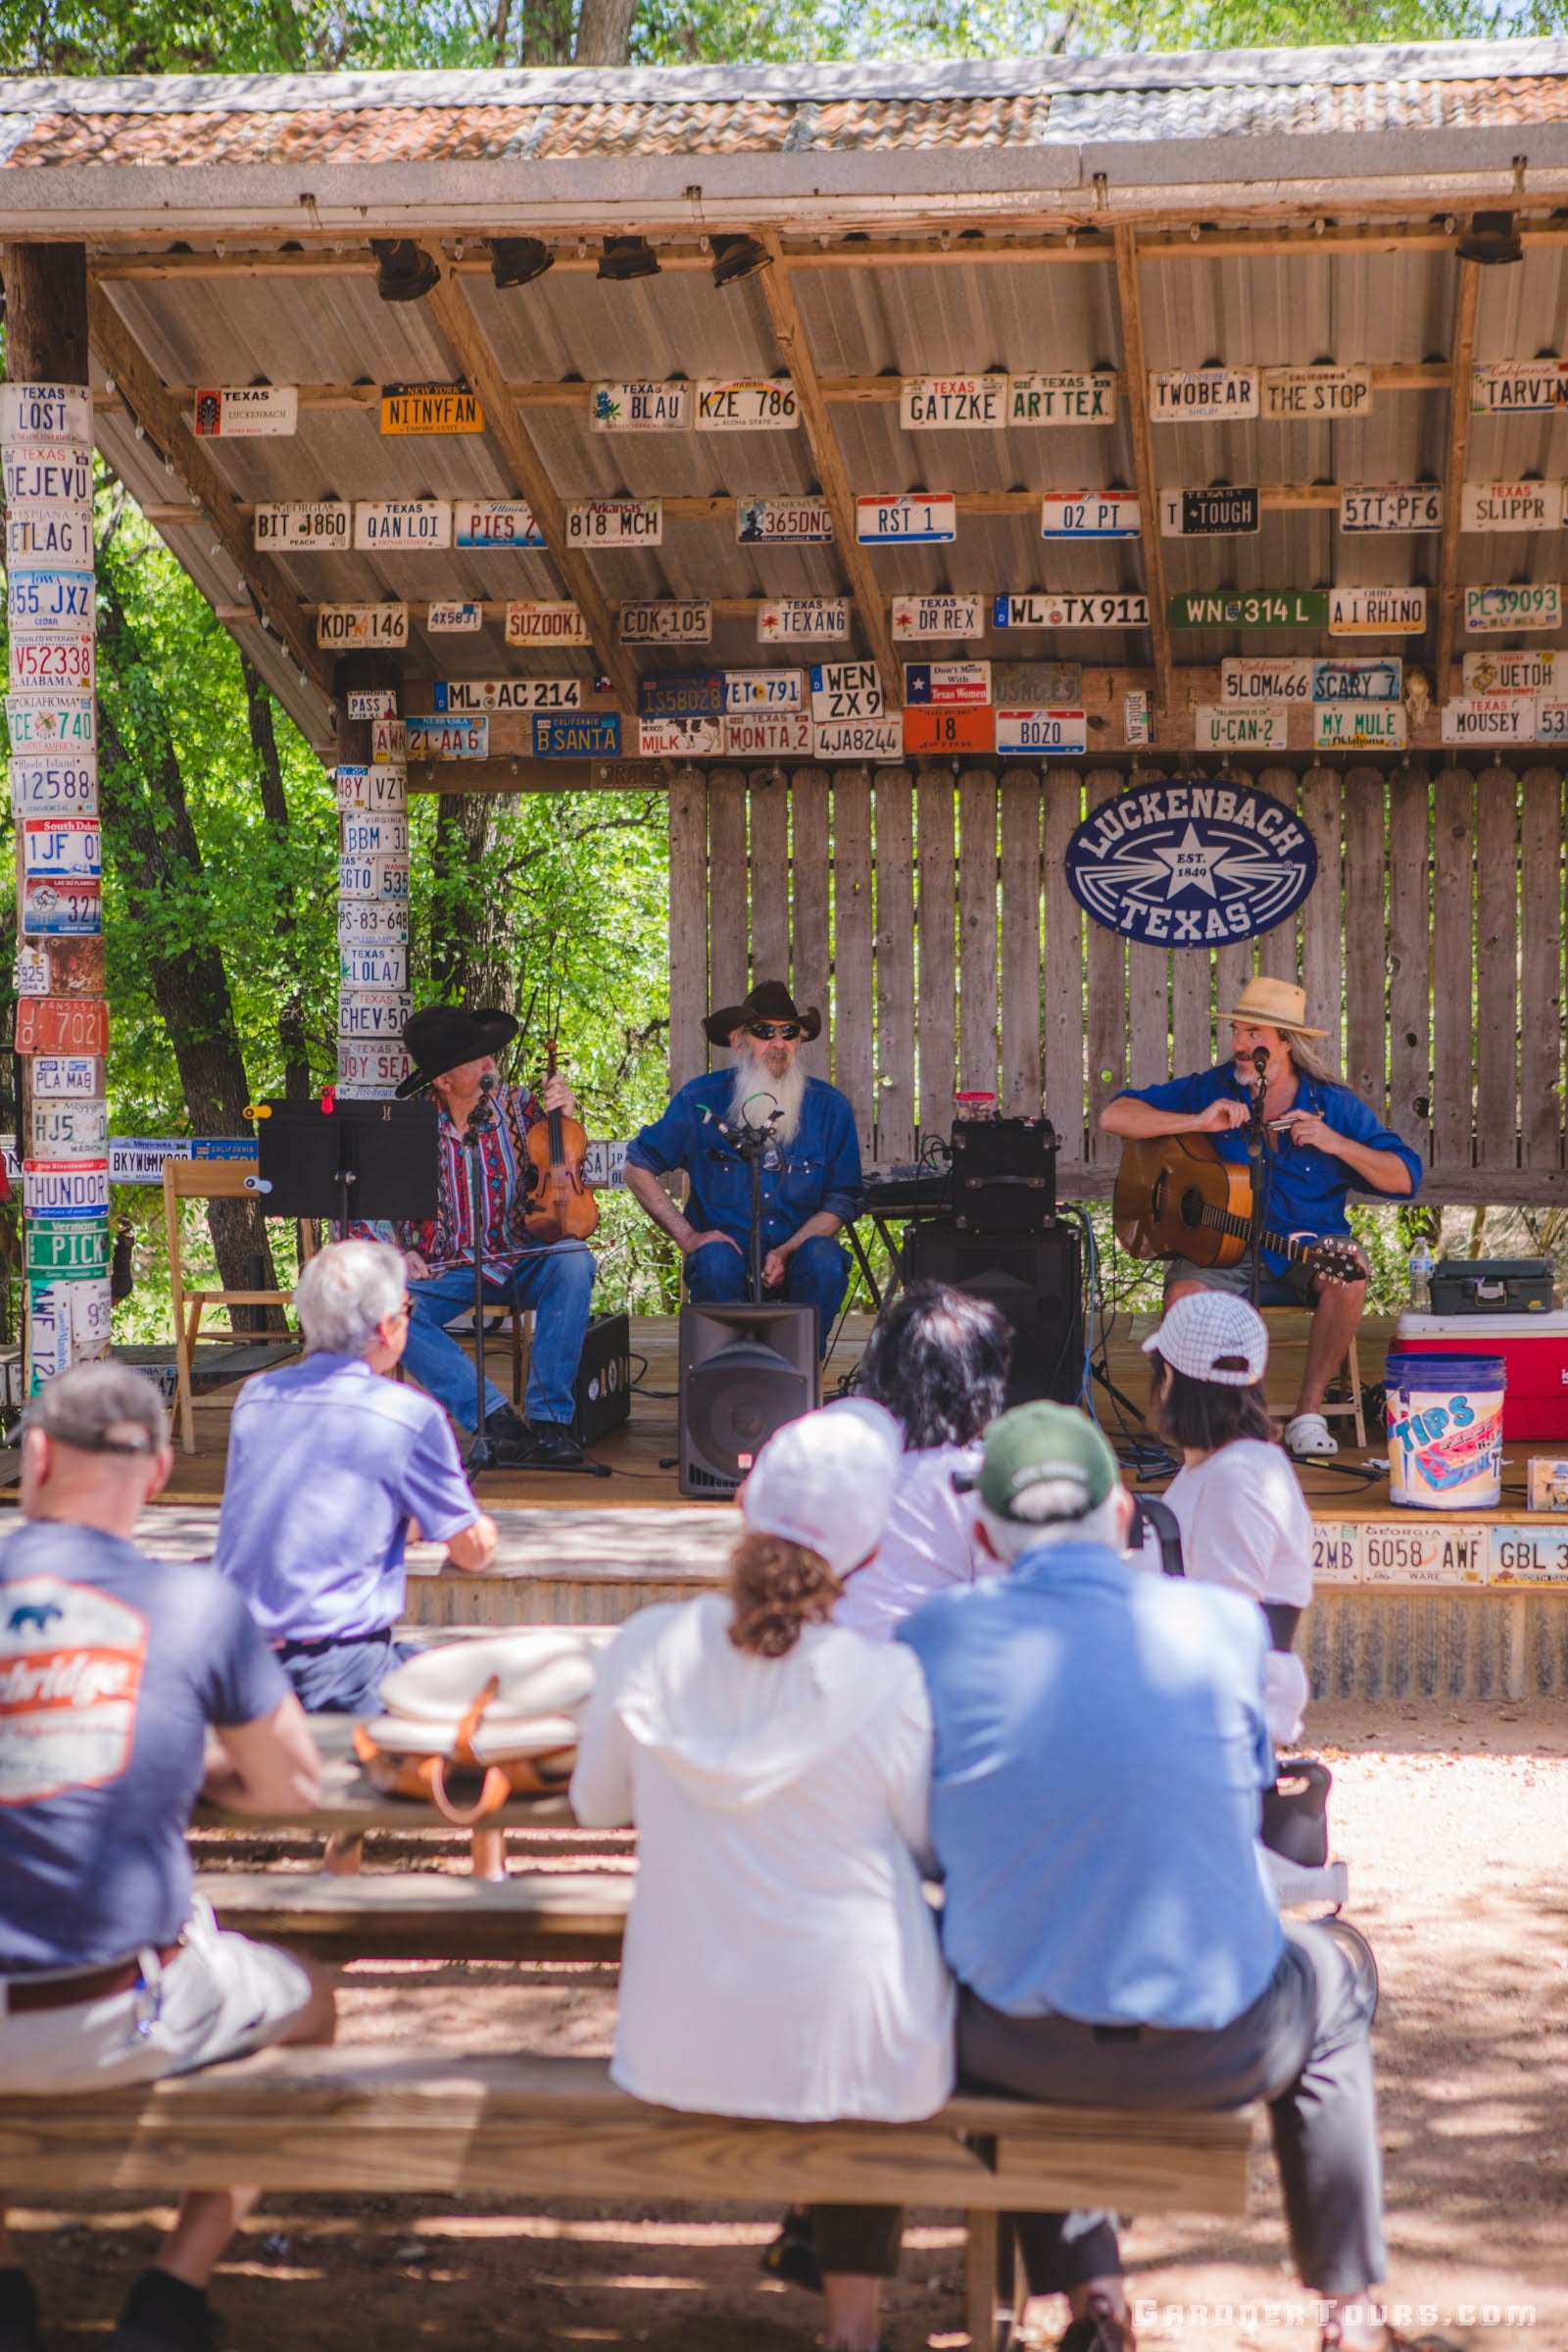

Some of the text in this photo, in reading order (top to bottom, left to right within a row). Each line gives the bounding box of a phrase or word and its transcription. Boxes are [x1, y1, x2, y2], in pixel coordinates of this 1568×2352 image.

[933, 381, 975, 394] TEXAS
[1041, 377, 1085, 388] TEXAS
[1289, 372, 1347, 382] CALIFORNIA
[22, 387, 65, 400] TEXAS
[222, 392, 270, 401] TEXAS
[699, 390, 795, 418] KZE 786
[1012, 391, 1104, 417] ART TEX
[1157, 380, 1250, 407] TWOBEAR
[1267, 384, 1367, 412] THE STOP
[20, 403, 66, 430] LOST
[228, 411, 286, 419] LUCKENBACH
[390, 397, 475, 424] NITNYFAN
[631, 396, 679, 419] BLAU
[910, 393, 997, 420] GATZKE
[23, 449, 66, 461] TEXAS
[1186, 490, 1234, 499] TEXAS
[1491, 485, 1532, 498] TEXAS
[276, 505, 327, 514] GEORGIA
[385, 504, 422, 514] TEXAS
[588, 503, 641, 514] Arkansas
[878, 508, 910, 532] RST
[1098, 505, 1120, 528] PT
[1199, 501, 1251, 524] TOUGH
[1346, 496, 1438, 521] 57T PF6
[1476, 499, 1544, 520] SLIPPR
[259, 514, 347, 538] BIT 1860
[367, 515, 439, 538] QAN LOI
[470, 515, 515, 539] PIES
[570, 513, 658, 536] 818 MCH
[51, 585, 88, 615] JXZ
[510, 604, 536, 612] Illinois
[787, 600, 822, 610] TEXAS
[1010, 598, 1149, 623] WL TX 911
[1186, 599, 1222, 622] WN
[1296, 598, 1309, 622] L
[1334, 599, 1422, 623] A RHINO
[320, 612, 404, 637] KDP 146
[624, 611, 707, 633] CDK 105
[919, 609, 974, 629] DR REX
[16, 646, 90, 675] V52338
[20, 676, 73, 686] ALABAMA
[826, 663, 876, 693] WEN
[1315, 674, 1396, 699] SCARY 7
[20, 697, 76, 708] OKLAHOMA
[449, 683, 578, 710] ML AC 214
[766, 680, 800, 703] 791
[932, 689, 955, 699] Texas
[956, 688, 986, 699] Women
[352, 698, 380, 713] PASS
[828, 691, 881, 717] ZX 9
[1470, 701, 1508, 712] TEXAS
[58, 711, 92, 741] 740
[753, 714, 787, 723] TEXAS
[935, 717, 956, 741] 18
[1322, 712, 1396, 736] MY MULE
[1456, 712, 1520, 733] MOUSEY
[410, 729, 431, 752] 21
[538, 728, 615, 752] B SANTA
[642, 736, 681, 752] MILK
[730, 725, 808, 749] MONTA 2
[819, 729, 897, 752] 4JA8244
[1020, 721, 1061, 745] BOZO
[1332, 735, 1385, 747] Oklahoma
[47, 759, 75, 768] Island
[44, 821, 74, 831] South
[1078, 788, 1305, 859] LUCKENBACH
[30, 834, 69, 859] 1JF
[348, 827, 380, 852] BBM
[1177, 854, 1206, 863] EST.
[1177, 867, 1207, 878] 1849
[1120, 896, 1251, 940] TEXAS
[352, 950, 385, 958] TEXAS
[40, 1002, 86, 1011] KANSAS
[360, 995, 393, 1004] TEXAS
[56, 1012, 102, 1045] 7021
[358, 1045, 392, 1054] TEXAS
[341, 1056, 410, 1078] JOY SEA
[36, 1072, 60, 1089] PLA
[132, 1140, 172, 1149] Minnesota
[28, 1175, 105, 1205] THUNDOR
[52, 1220, 98, 1232] Vermont
[1396, 1396, 1475, 1452] TIPS
[1365, 1527, 1442, 1537] GEORGIA
[1368, 1540, 1483, 1569] 6058 AWF
[1500, 1542, 1546, 1570] GBL
[1409, 1572, 1442, 1583] WARE
